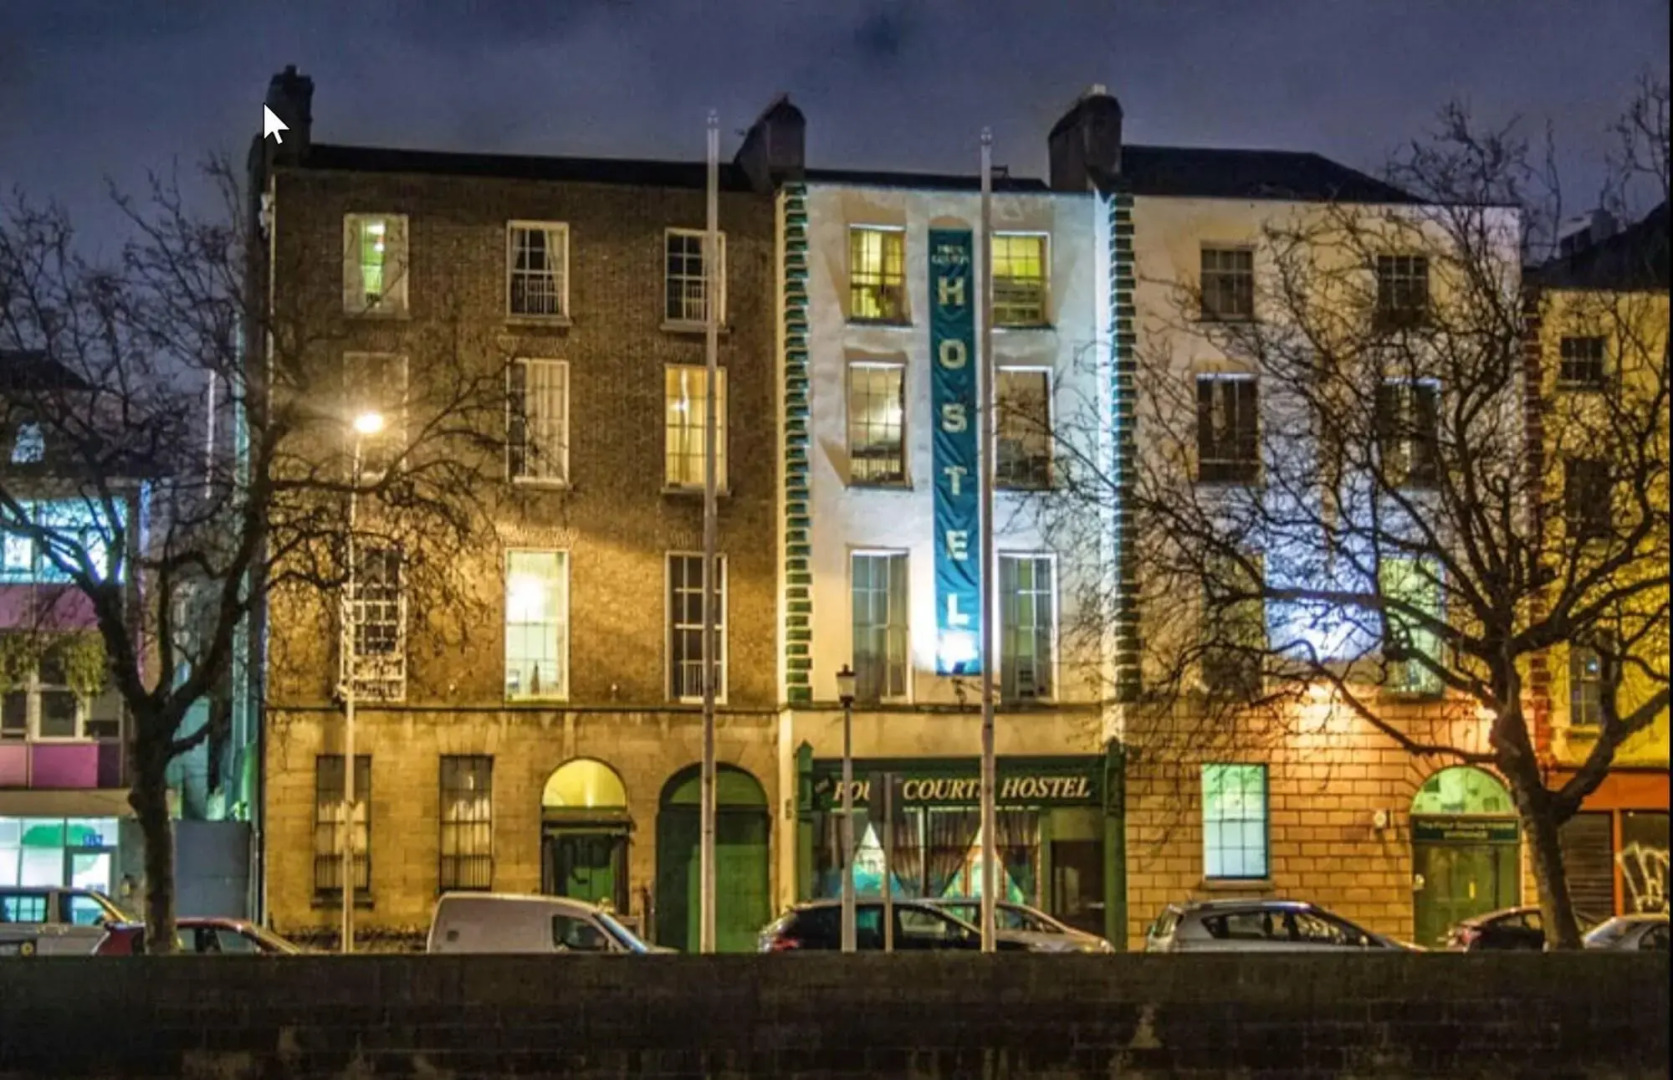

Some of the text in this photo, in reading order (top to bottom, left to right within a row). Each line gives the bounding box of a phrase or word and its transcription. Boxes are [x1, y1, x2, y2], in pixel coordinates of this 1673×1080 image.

[938, 276, 970, 626] HOSTEL
[903, 779, 981, 800] COURT
[1000, 777, 1091, 798] HOSTEL
